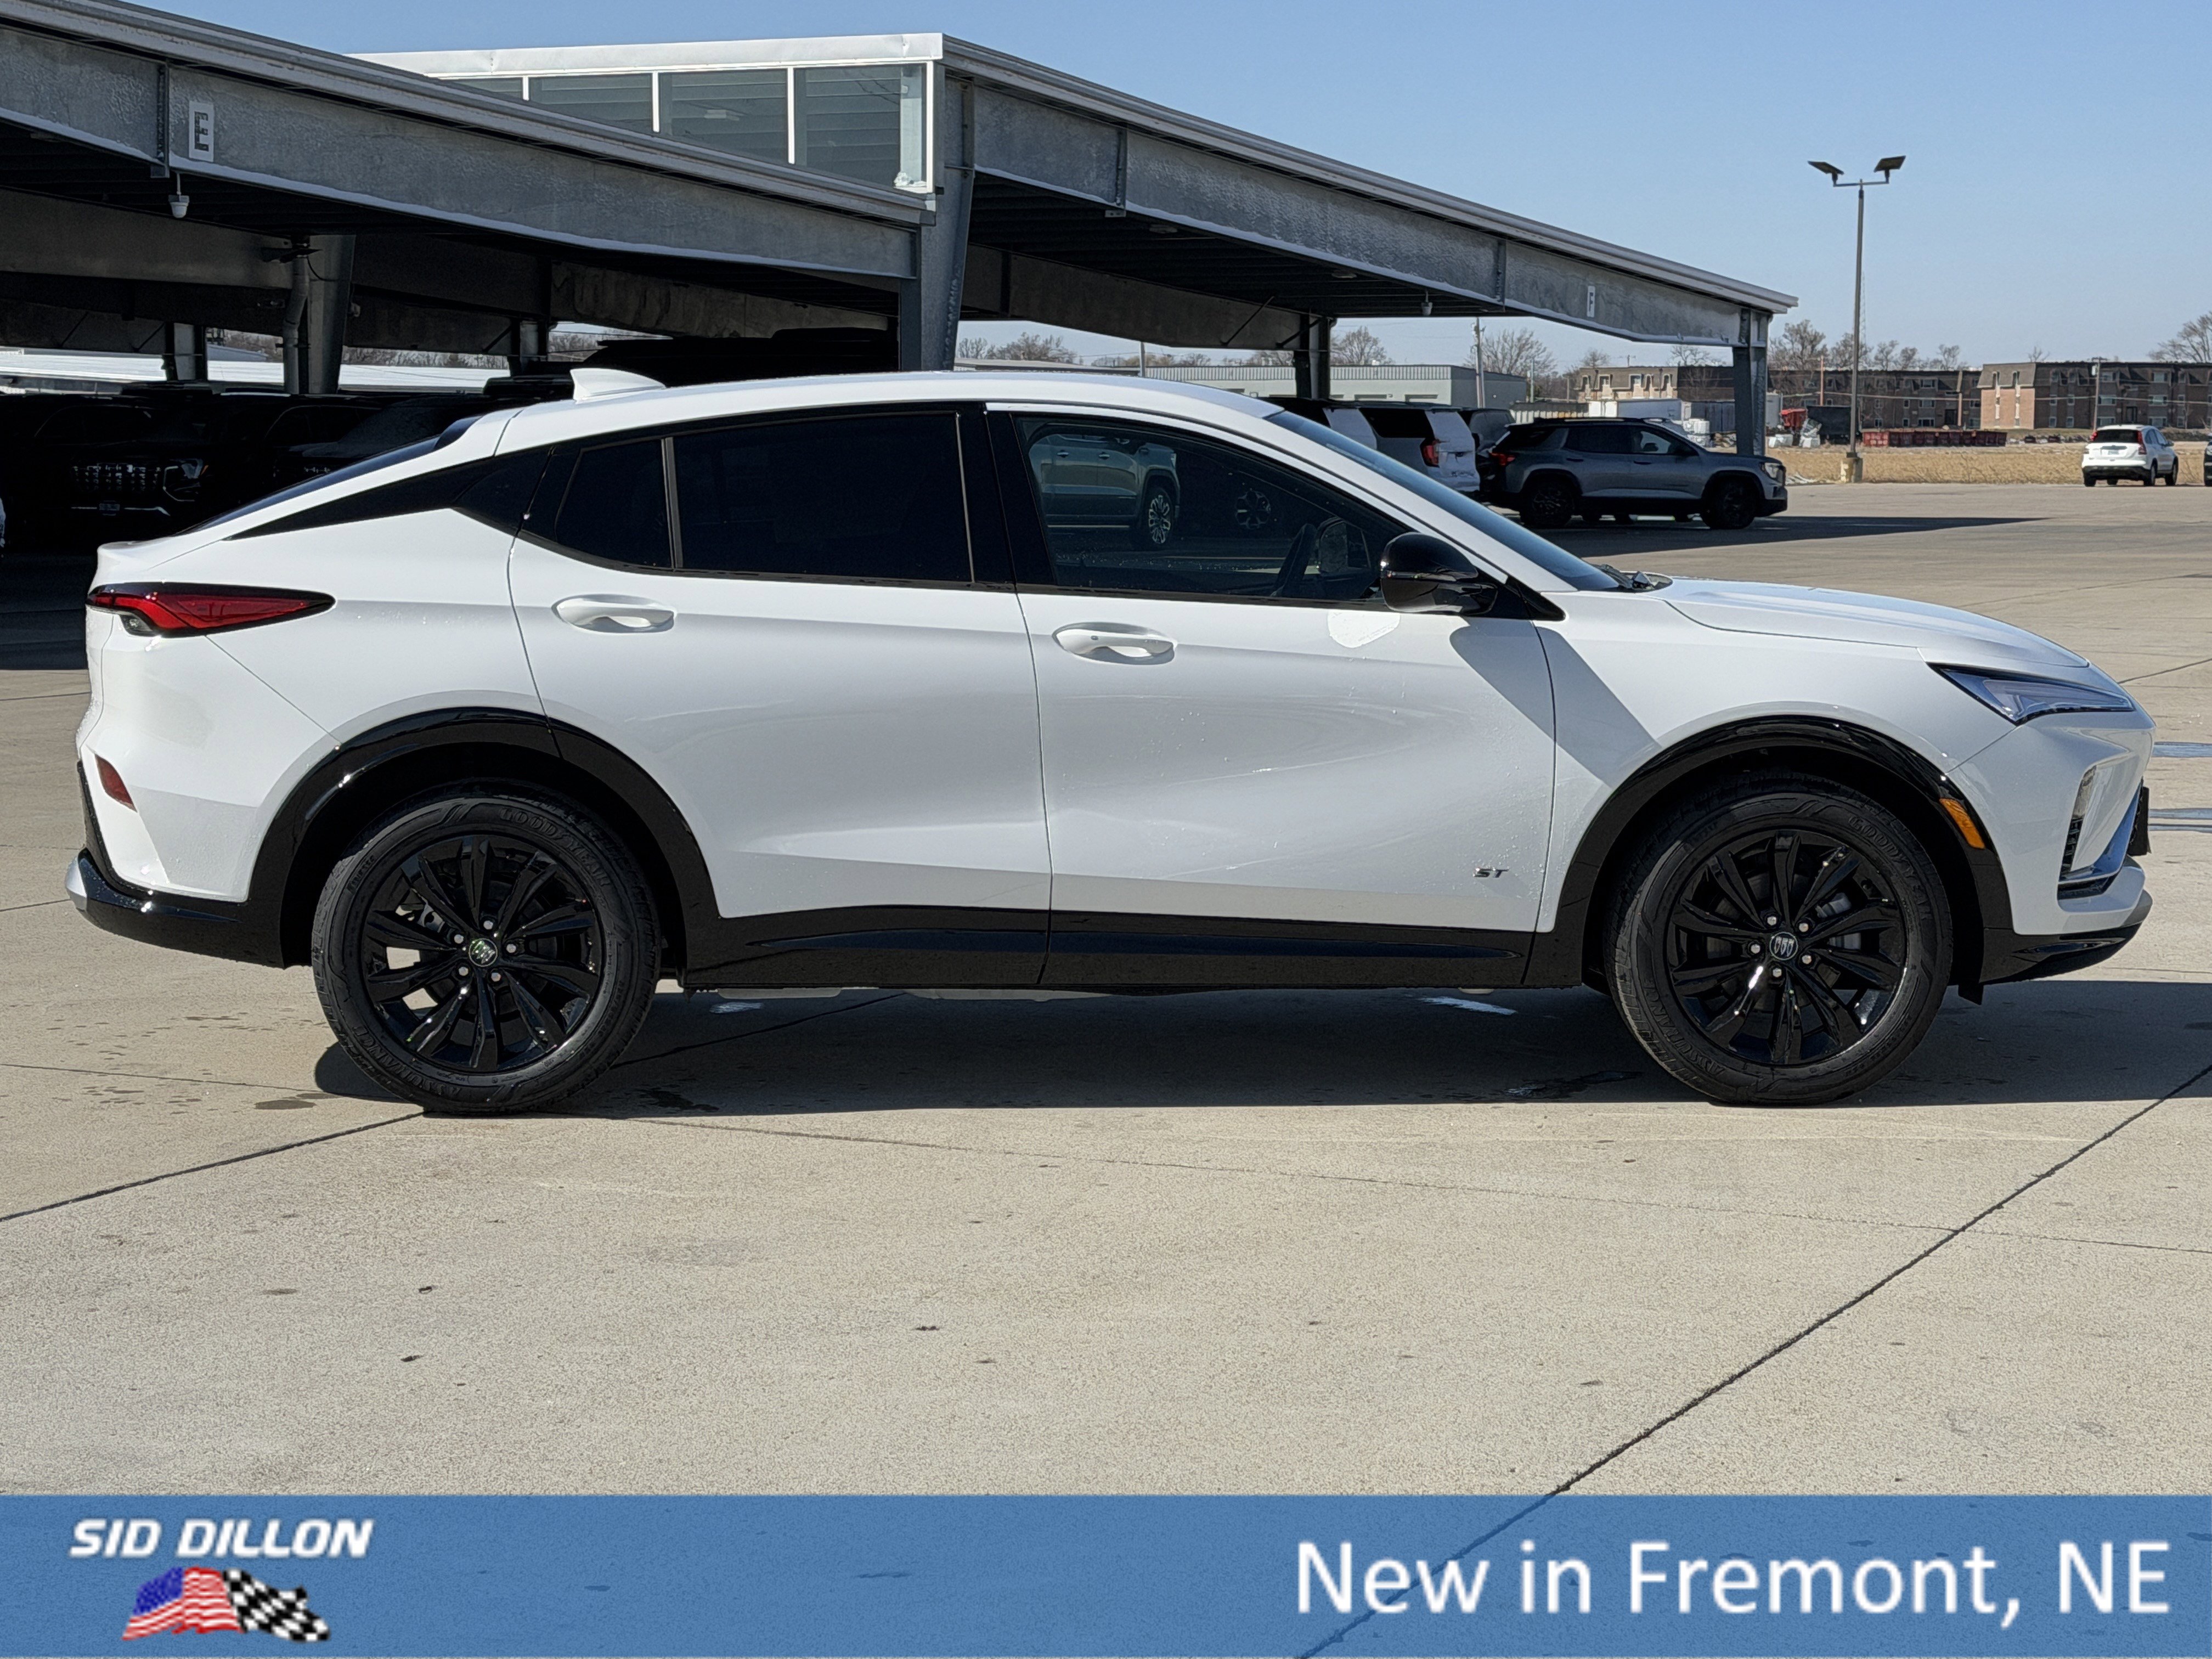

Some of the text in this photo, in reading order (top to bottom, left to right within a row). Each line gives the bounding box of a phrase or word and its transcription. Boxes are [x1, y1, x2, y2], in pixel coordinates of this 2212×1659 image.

[194, 111, 209, 152] E
[499, 808, 611, 887] GOODYEAR
[1472, 868, 1509, 878] ST
[1848, 816, 1933, 921] GOODYEAR
